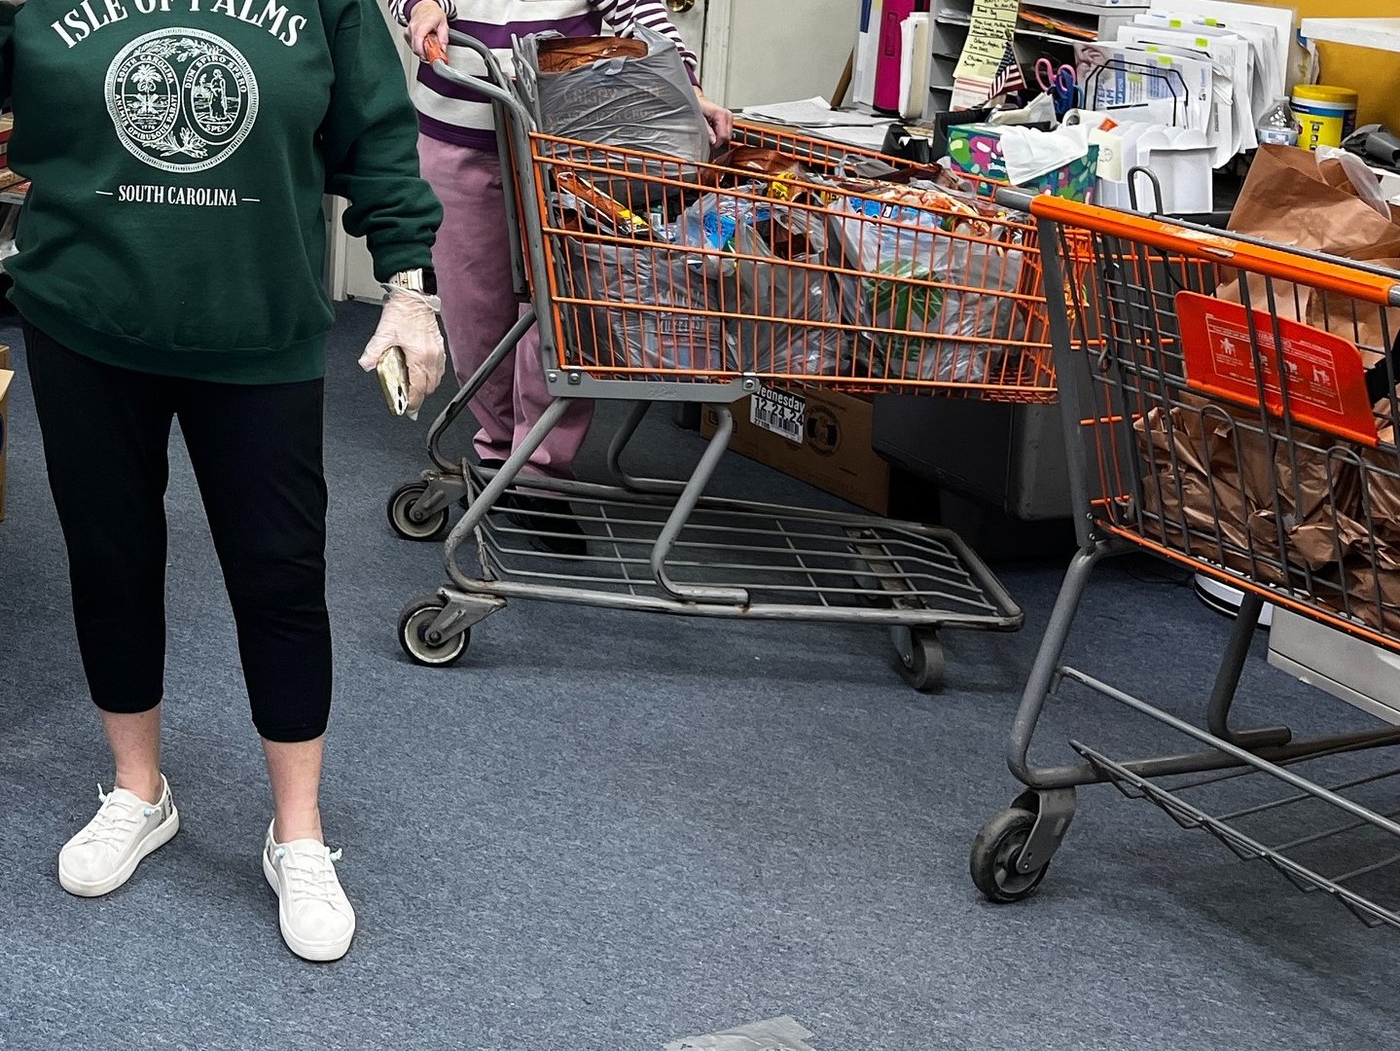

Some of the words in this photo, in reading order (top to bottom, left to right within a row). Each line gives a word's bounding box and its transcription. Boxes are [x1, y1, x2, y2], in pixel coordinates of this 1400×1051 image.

[117, 57, 137, 83] SOUTH
[140, 54, 175, 84] CAROLINA
[185, 70, 197, 89] DUM
[196, 54, 225, 68] SPIRO
[228, 60, 247, 94] SPERO
[114, 94, 129, 128] ANIMIS
[166, 94, 178, 124] PARATI
[205, 124, 228, 133] SPES
[118, 185, 164, 203] SOUTH
[167, 186, 237, 206] CAROLINA
[757, 386, 805, 414] ednesday
